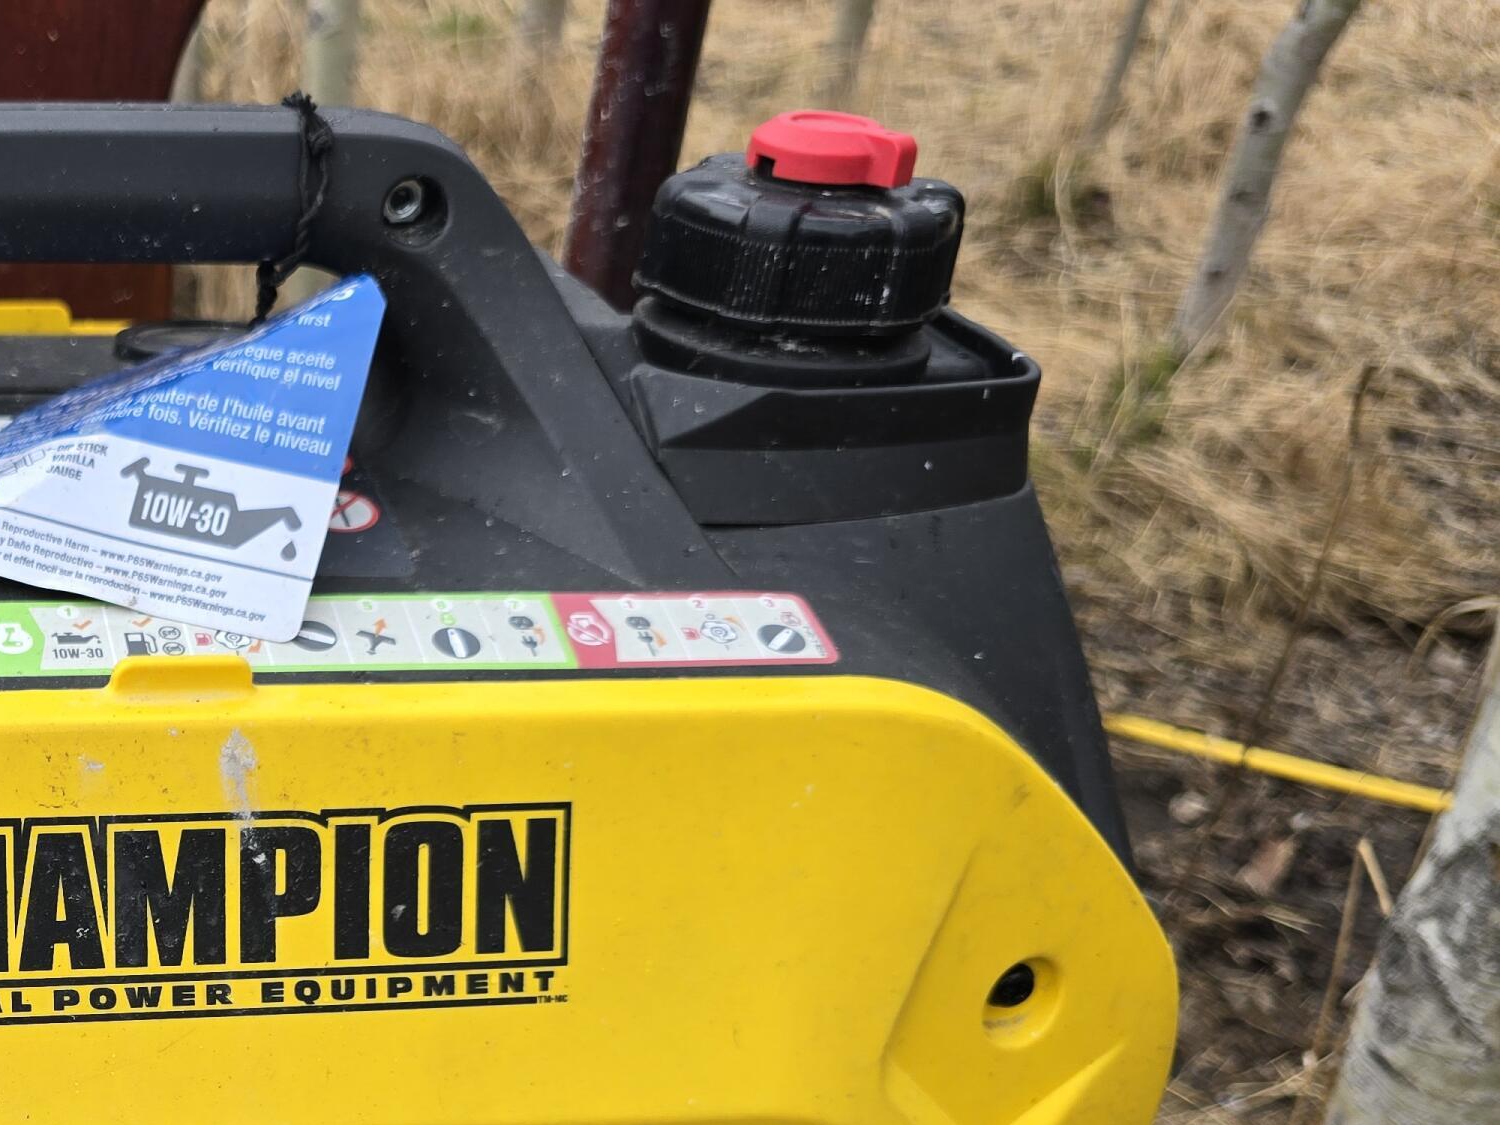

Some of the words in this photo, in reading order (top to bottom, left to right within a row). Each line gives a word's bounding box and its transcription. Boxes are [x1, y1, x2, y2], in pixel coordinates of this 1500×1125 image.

[286, 352, 335, 370] aceite
[283, 368, 300, 383] el
[302, 372, 342, 391] nivel
[197, 394, 218, 413] de
[221, 398, 273, 423] l'huile
[277, 410, 325, 434] avant
[148, 404, 181, 426] fois.
[188, 411, 251, 440] Vérifiez
[255, 425, 270, 444] le
[274, 431, 332, 457] niveau
[76, 442, 109, 456] STICK
[45, 465, 83, 480] JAUGE
[141, 489, 231, 537] 10W-30
[1, 518, 62, 546] Reproductive
[64, 537, 90, 553] Harm
[100, 549, 223, 583] www.P65Warnings.ca.gov
[0, 536, 5, 546] y
[7, 537, 31, 551] Daño
[32, 545, 94, 570] Reproductivo
[104, 565, 227, 599] www.P65Warnings.ca.gov
[3, 552, 13, 562] et
[13, 553, 34, 569] effet
[59, 567, 74, 577] sur
[74, 569, 83, 580] la
[84, 571, 140, 595] reproduction
[149, 590, 266, 623] www.P65Warnings.ca.gov
[692, 599, 704, 609] 2
[765, 599, 775, 608] 3
[53, 648, 104, 659] 10W-30
[54, 982, 233, 1011] POWER
[261, 970, 557, 1004] EQUIPMENT
